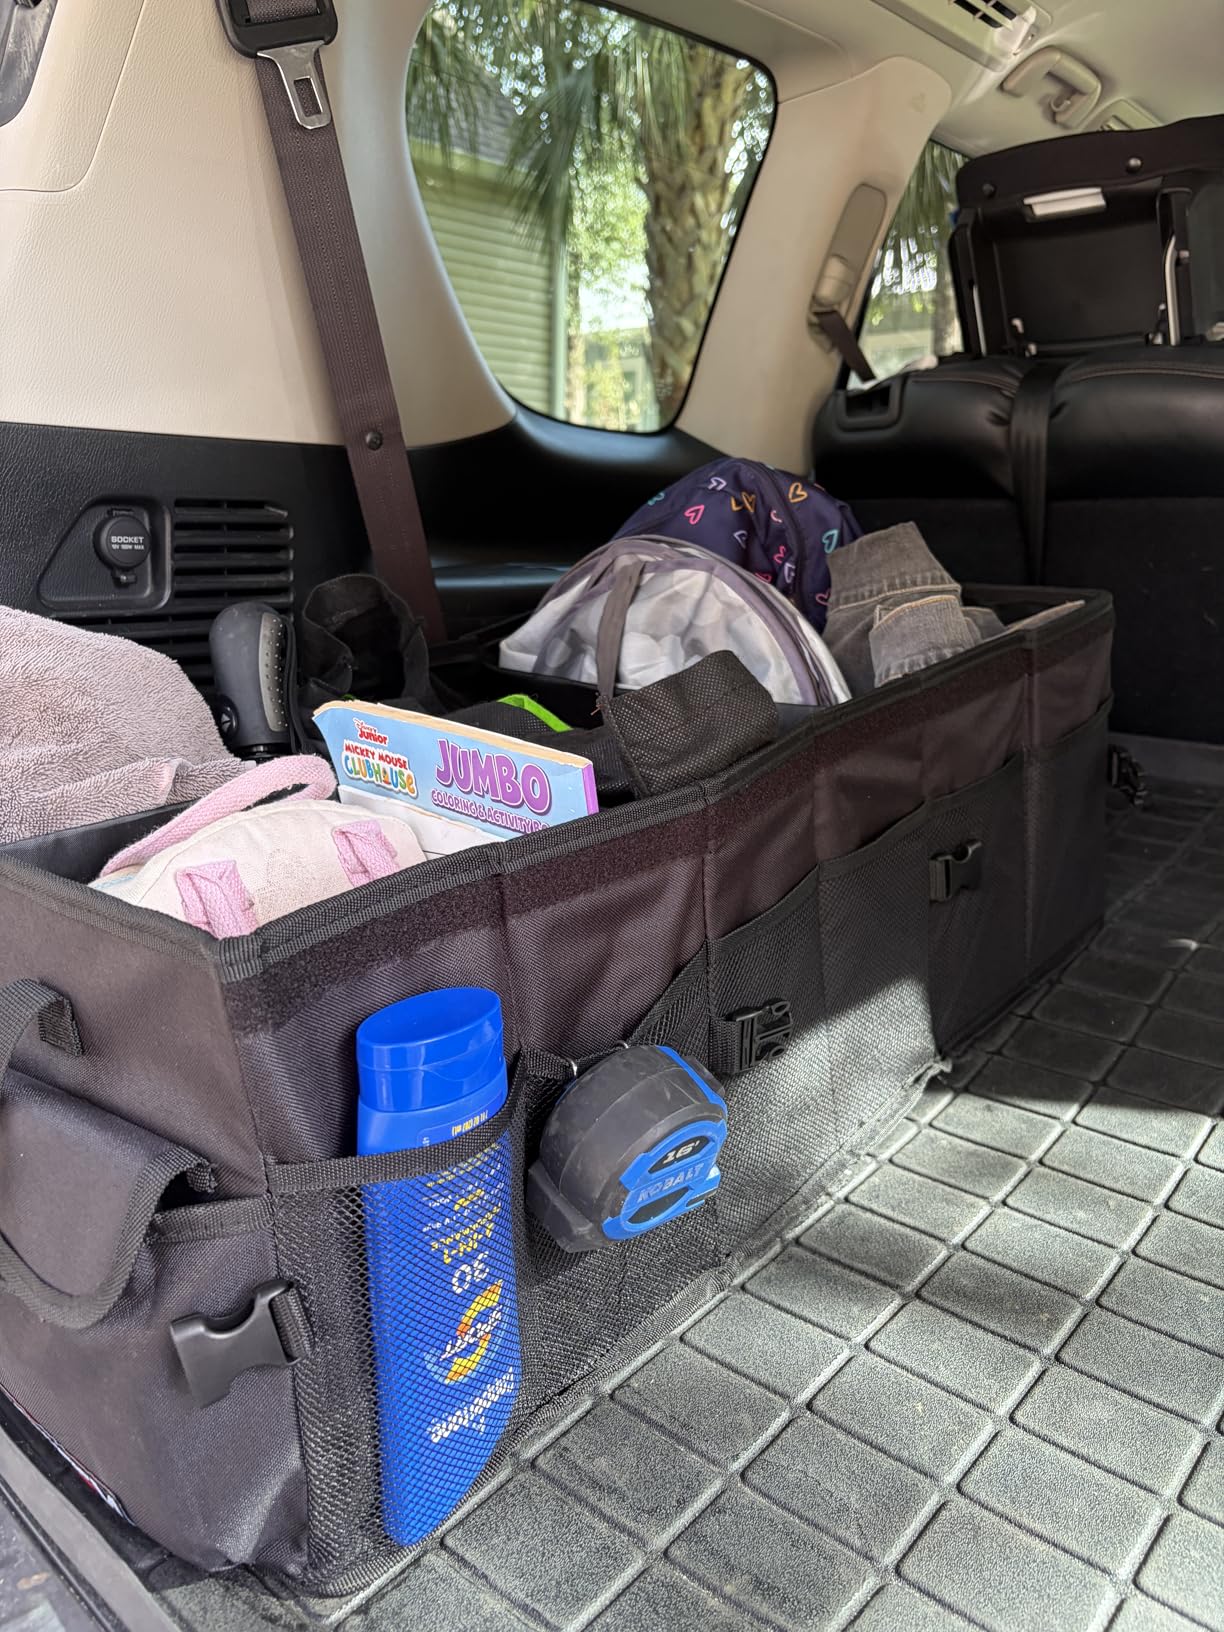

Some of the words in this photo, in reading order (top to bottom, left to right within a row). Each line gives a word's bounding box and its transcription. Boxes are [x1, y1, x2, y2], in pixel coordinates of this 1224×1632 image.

[111, 535, 145, 544] SOCKET
[345, 742, 376, 760] MICKEY
[378, 751, 408, 770] MOUSE
[359, 729, 388, 745] Junior
[436, 738, 552, 815] JUMBO
[431, 788, 478, 818] COLORING
[478, 803, 486, 820] &
[486, 806, 532, 834] ACTIVITY
[638, 1163, 705, 1201] KOBALT
[452, 1251, 490, 1294] 30
